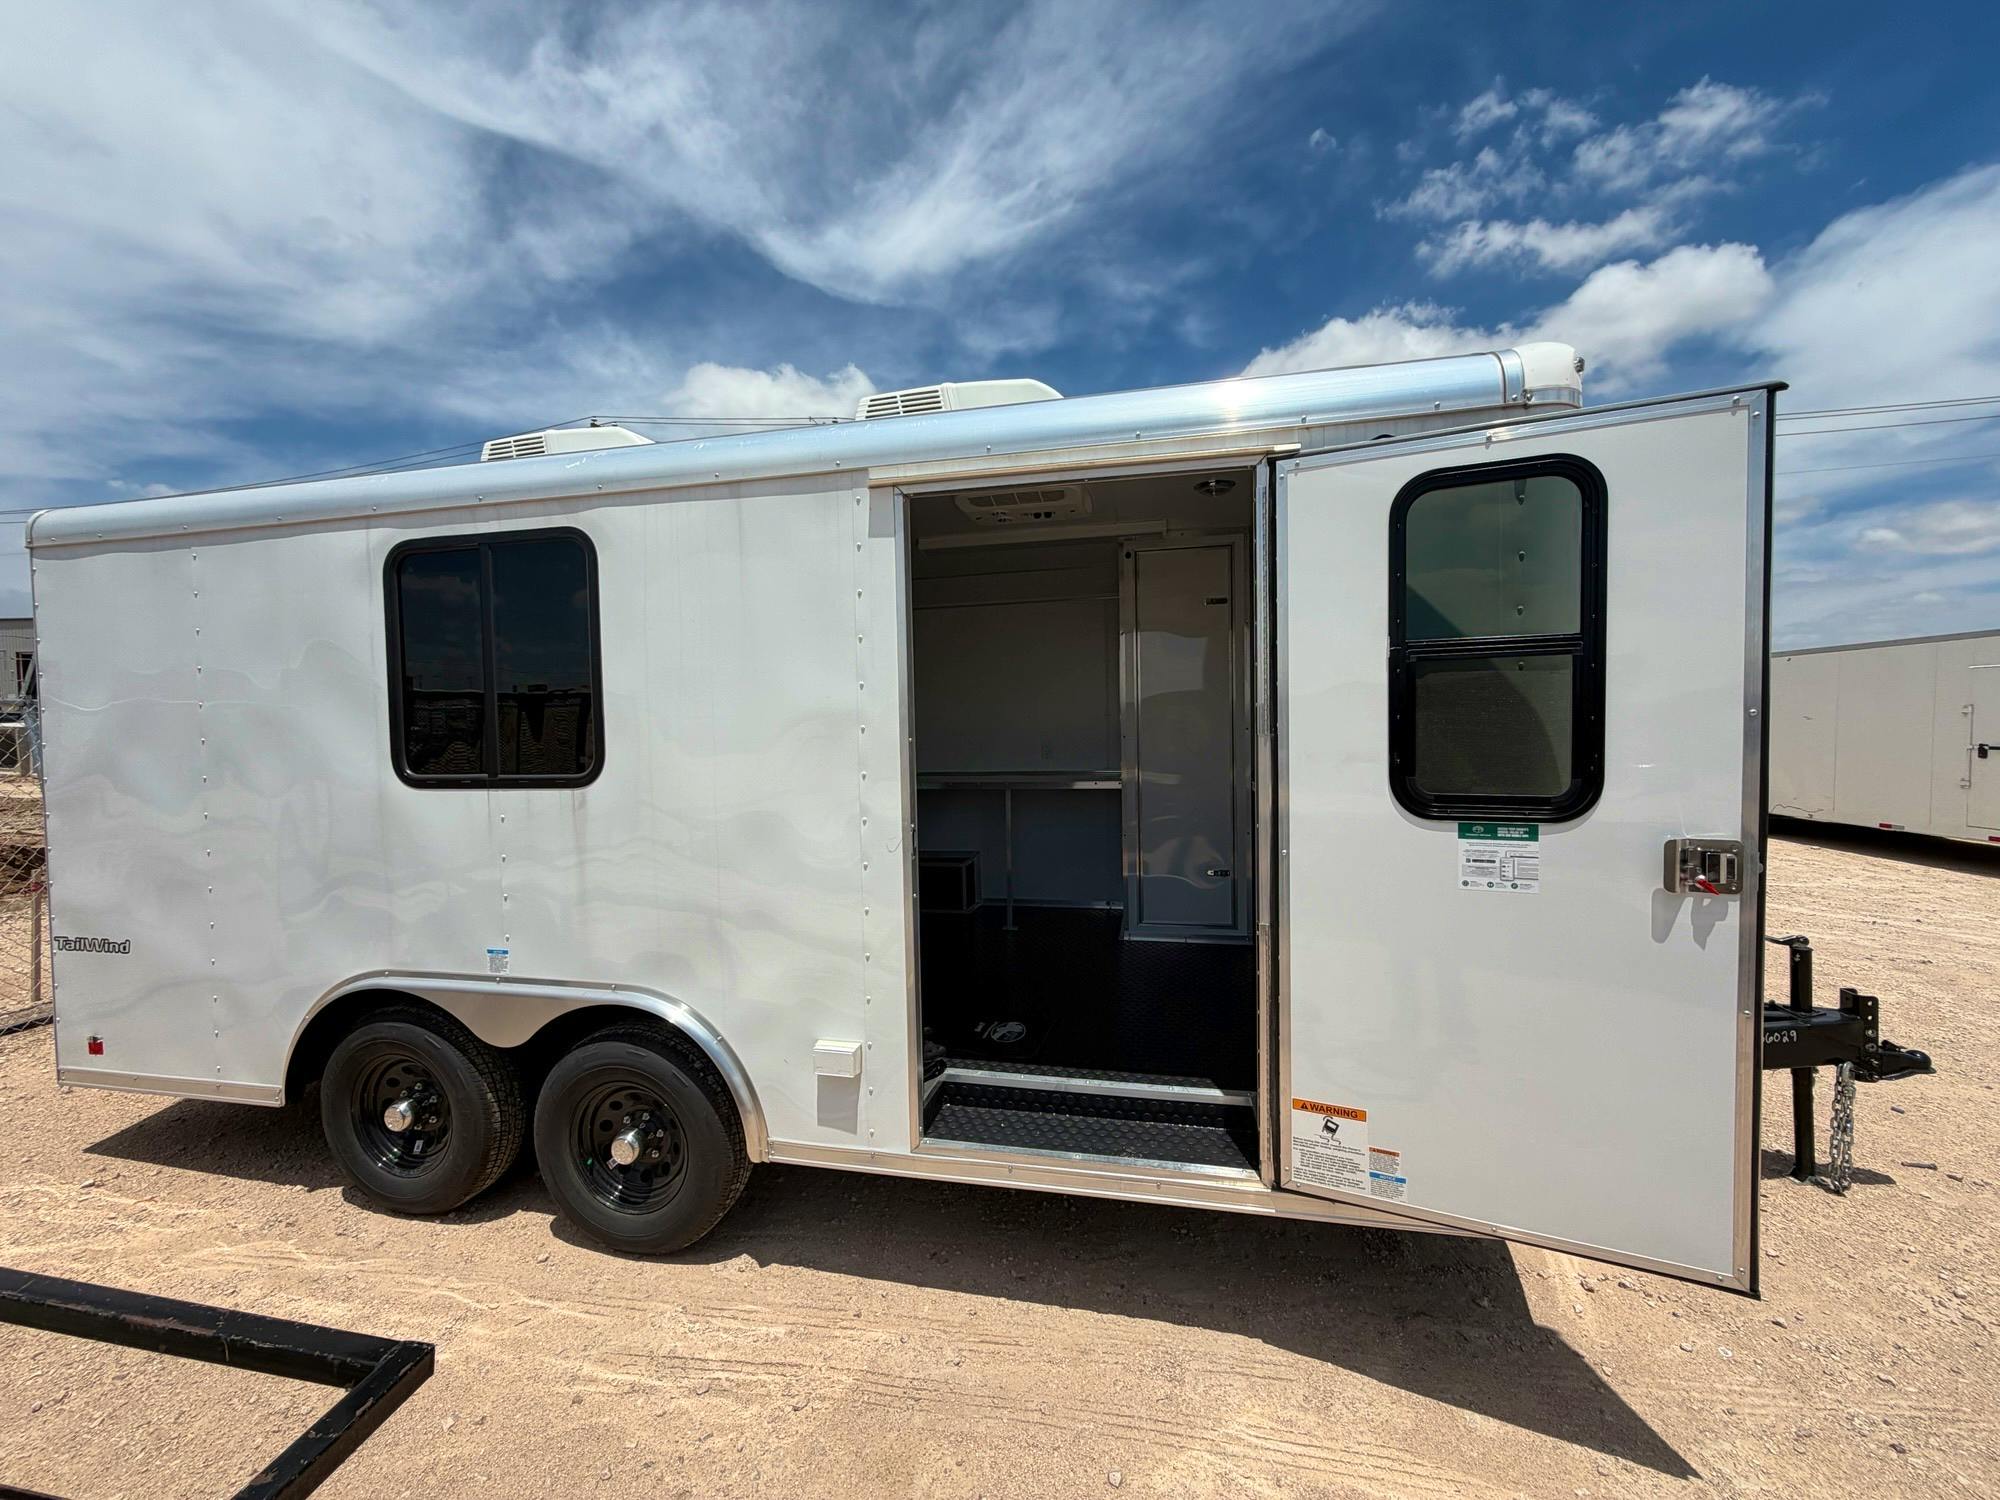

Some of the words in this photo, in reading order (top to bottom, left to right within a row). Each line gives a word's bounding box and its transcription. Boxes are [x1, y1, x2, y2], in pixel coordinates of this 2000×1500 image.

[54, 936, 131, 954] TailWind
[1763, 1030, 1797, 1044] 6029
[1309, 1103, 1359, 1119] WARNING
